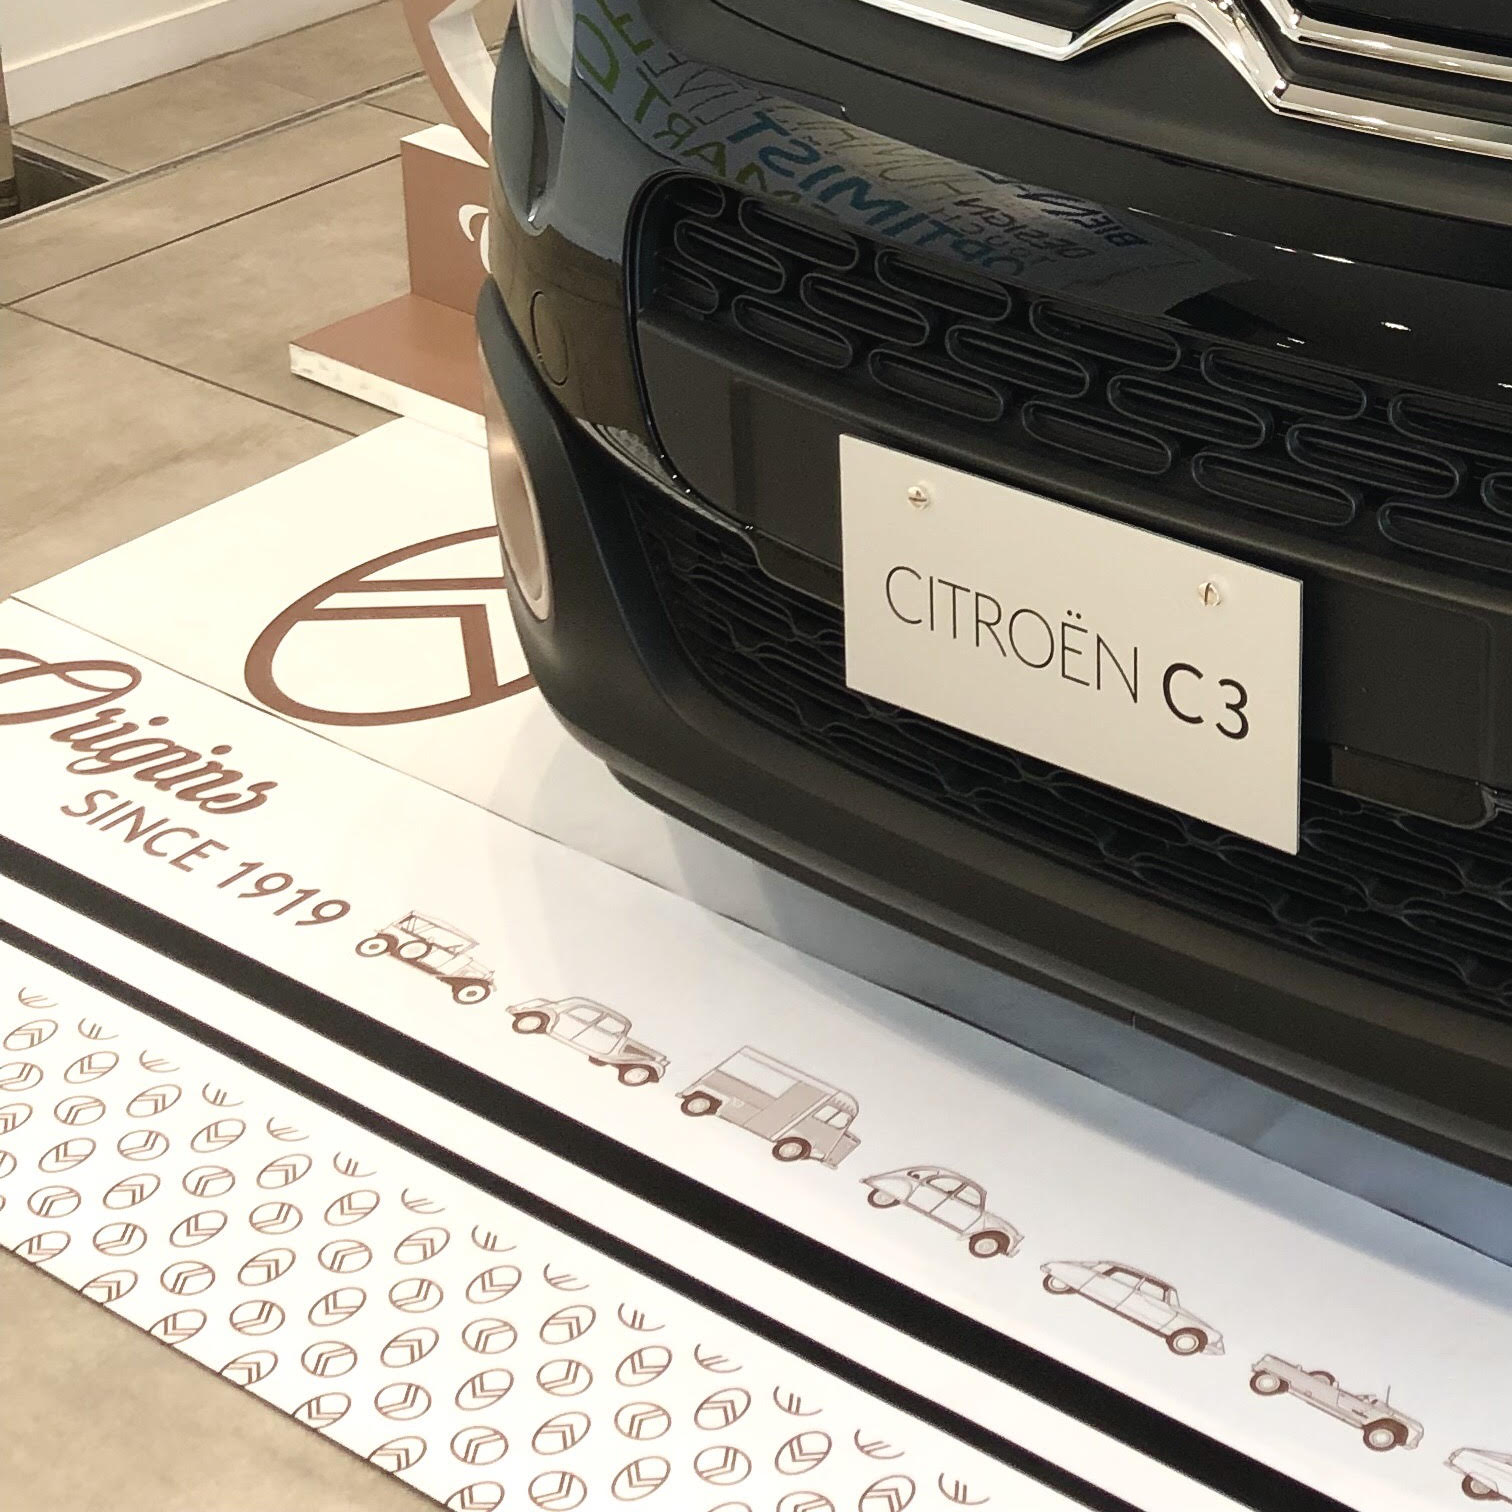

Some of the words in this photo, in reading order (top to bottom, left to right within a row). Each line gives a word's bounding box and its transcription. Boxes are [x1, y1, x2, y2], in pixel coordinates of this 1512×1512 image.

[885, 565, 1139, 704] CITROËN
[1162, 661, 1251, 740] C3
[59, 789, 231, 873] SINCE
[216, 860, 352, 926] 1919
